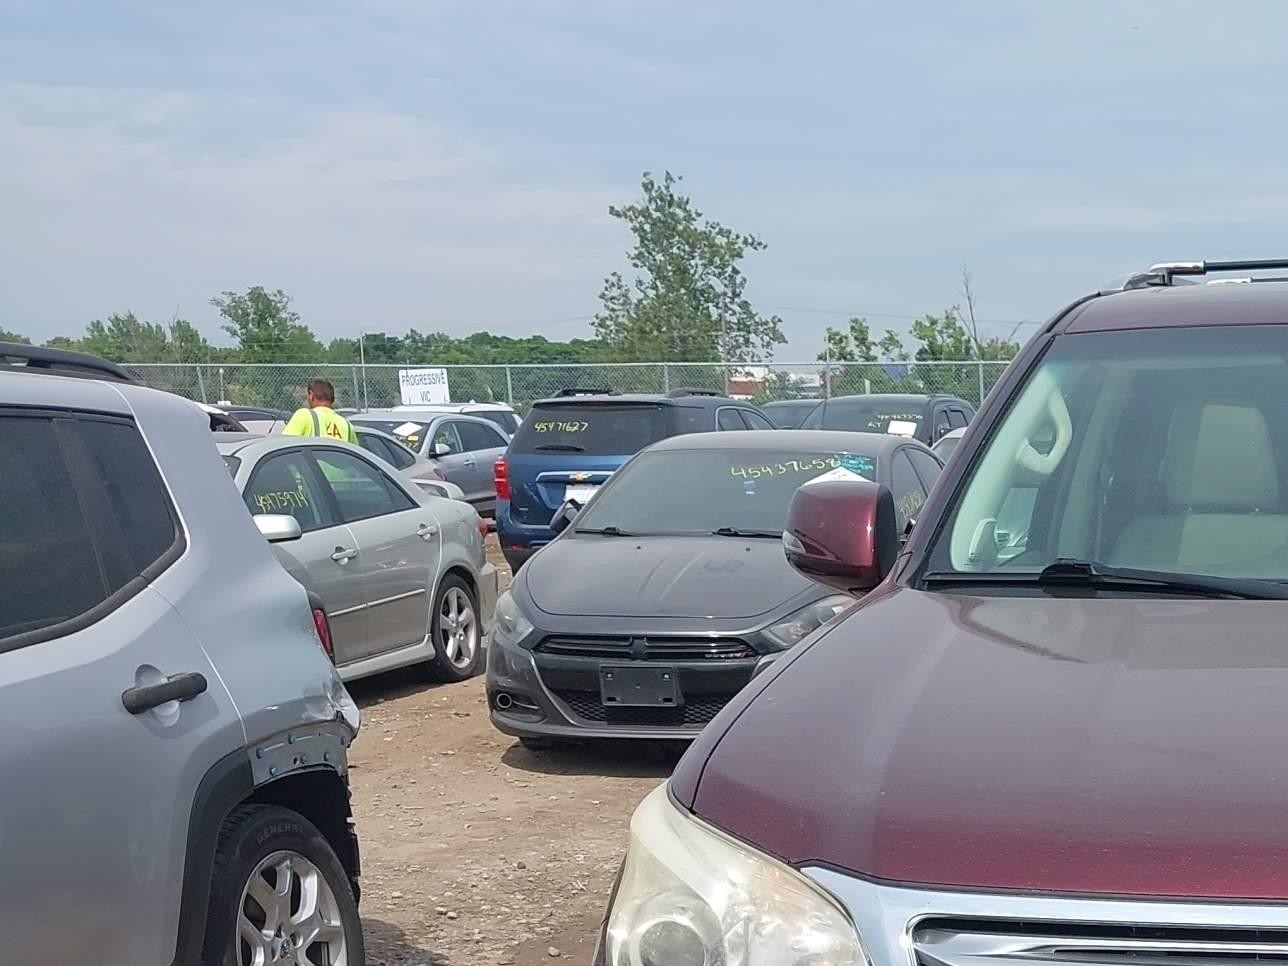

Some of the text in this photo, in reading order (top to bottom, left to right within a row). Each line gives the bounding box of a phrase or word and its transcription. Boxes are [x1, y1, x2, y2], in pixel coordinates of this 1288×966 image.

[401, 372, 446, 386] PROGRESSIVE
[420, 390, 431, 403] VIC
[534, 421, 589, 433] 45471627
[730, 455, 841, 479] 45437658
